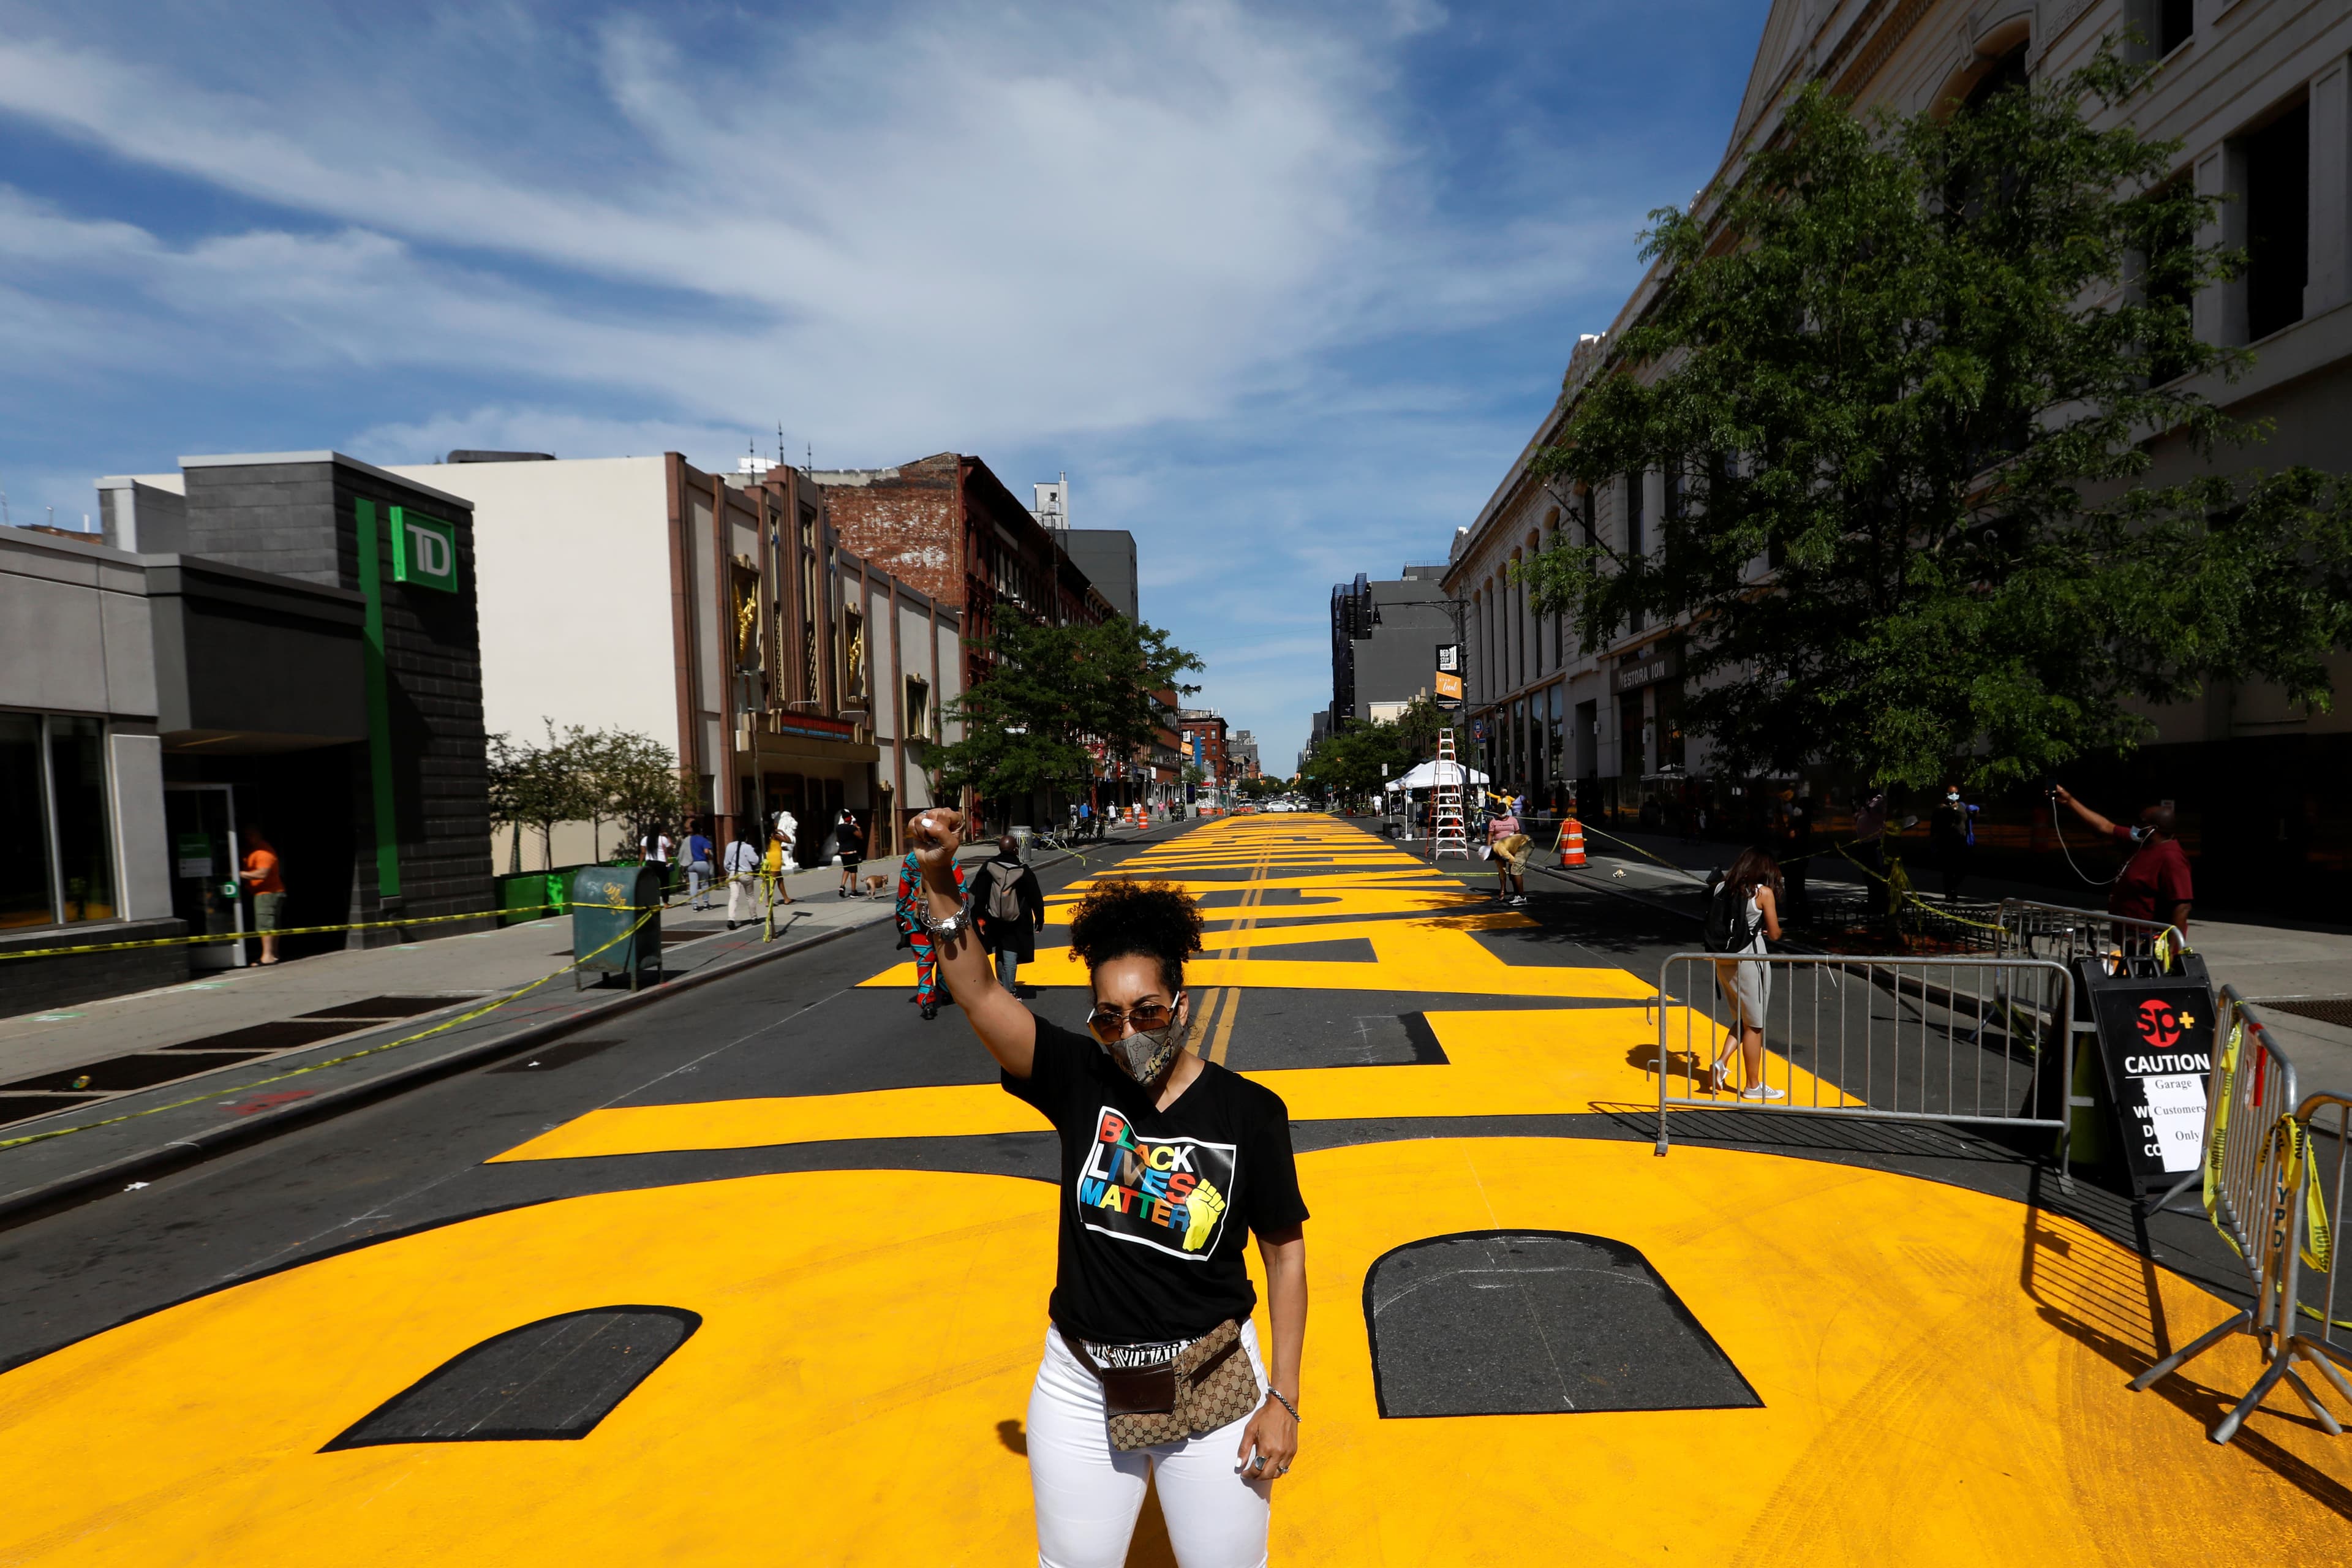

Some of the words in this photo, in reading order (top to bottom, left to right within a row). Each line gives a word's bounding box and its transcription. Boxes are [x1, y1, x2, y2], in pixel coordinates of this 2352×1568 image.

[405, 523, 451, 577] TD
[2125, 1053, 2210, 1074] CAUTION
[2155, 1079, 2192, 1090] Garage
[2154, 1105, 2206, 1116] Customers
[1099, 1114, 1196, 1172] BLACK
[2175, 1130, 2199, 1142] Only
[1088, 1142, 1196, 1204] LIVES
[1080, 1177, 1191, 1232] MATTER
